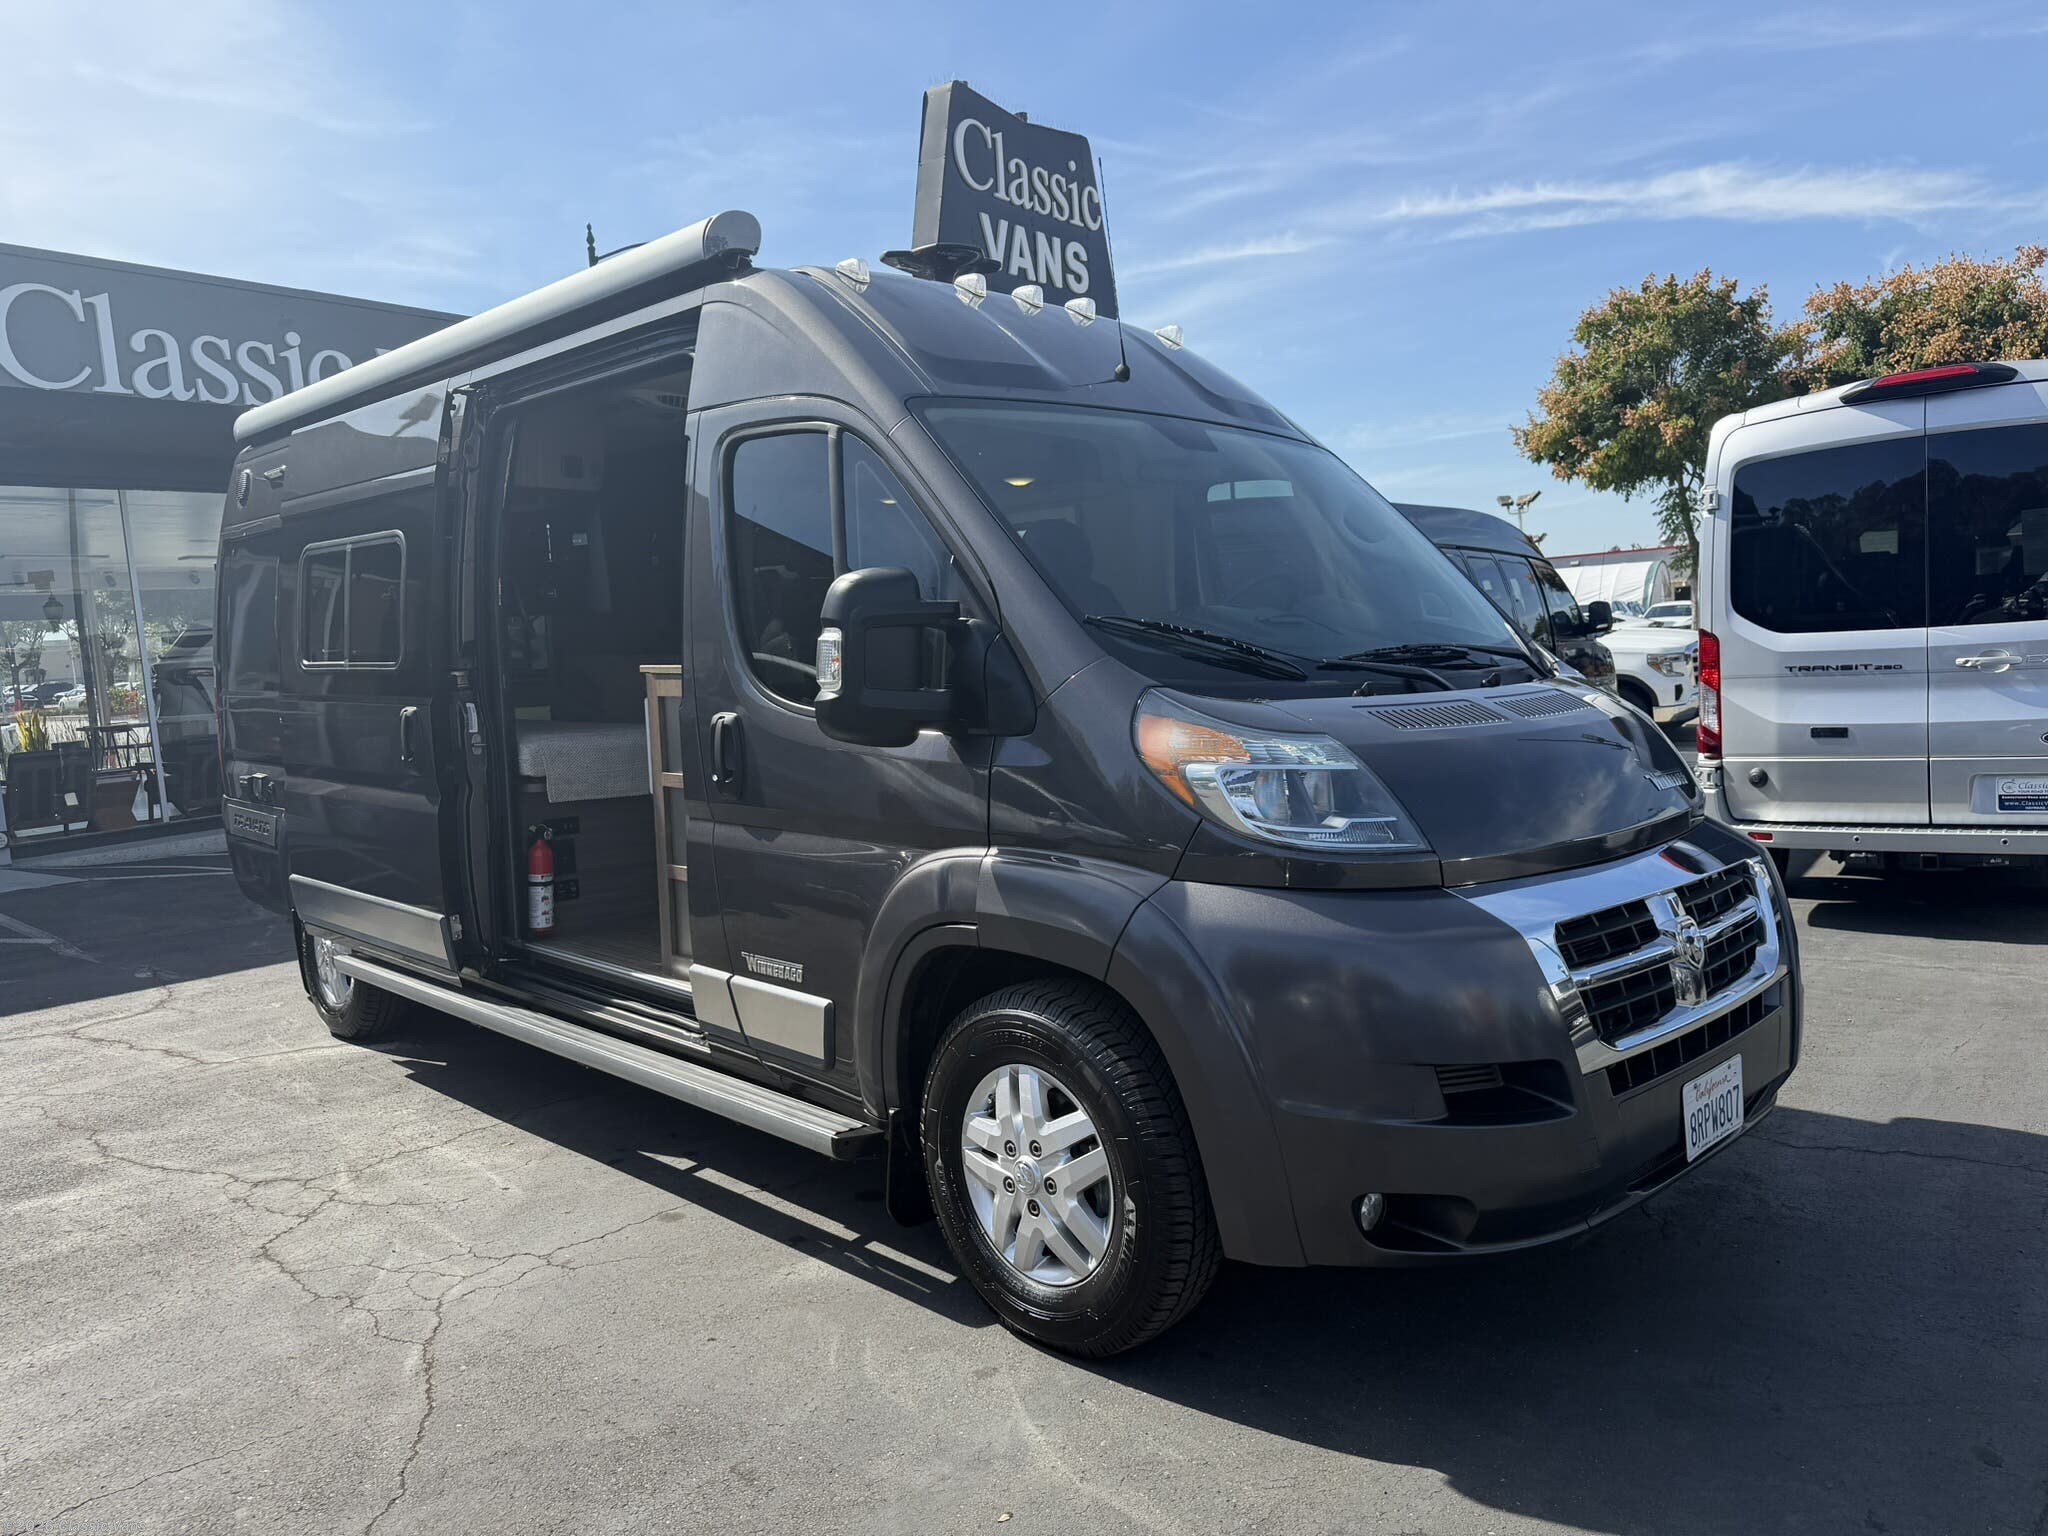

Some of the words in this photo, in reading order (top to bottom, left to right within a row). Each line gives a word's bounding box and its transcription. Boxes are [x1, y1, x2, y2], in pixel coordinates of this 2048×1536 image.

[953, 118, 1101, 231] Classic
[979, 212, 1090, 295] VANS
[1690, 1084, 1740, 1147] 8RPW807
